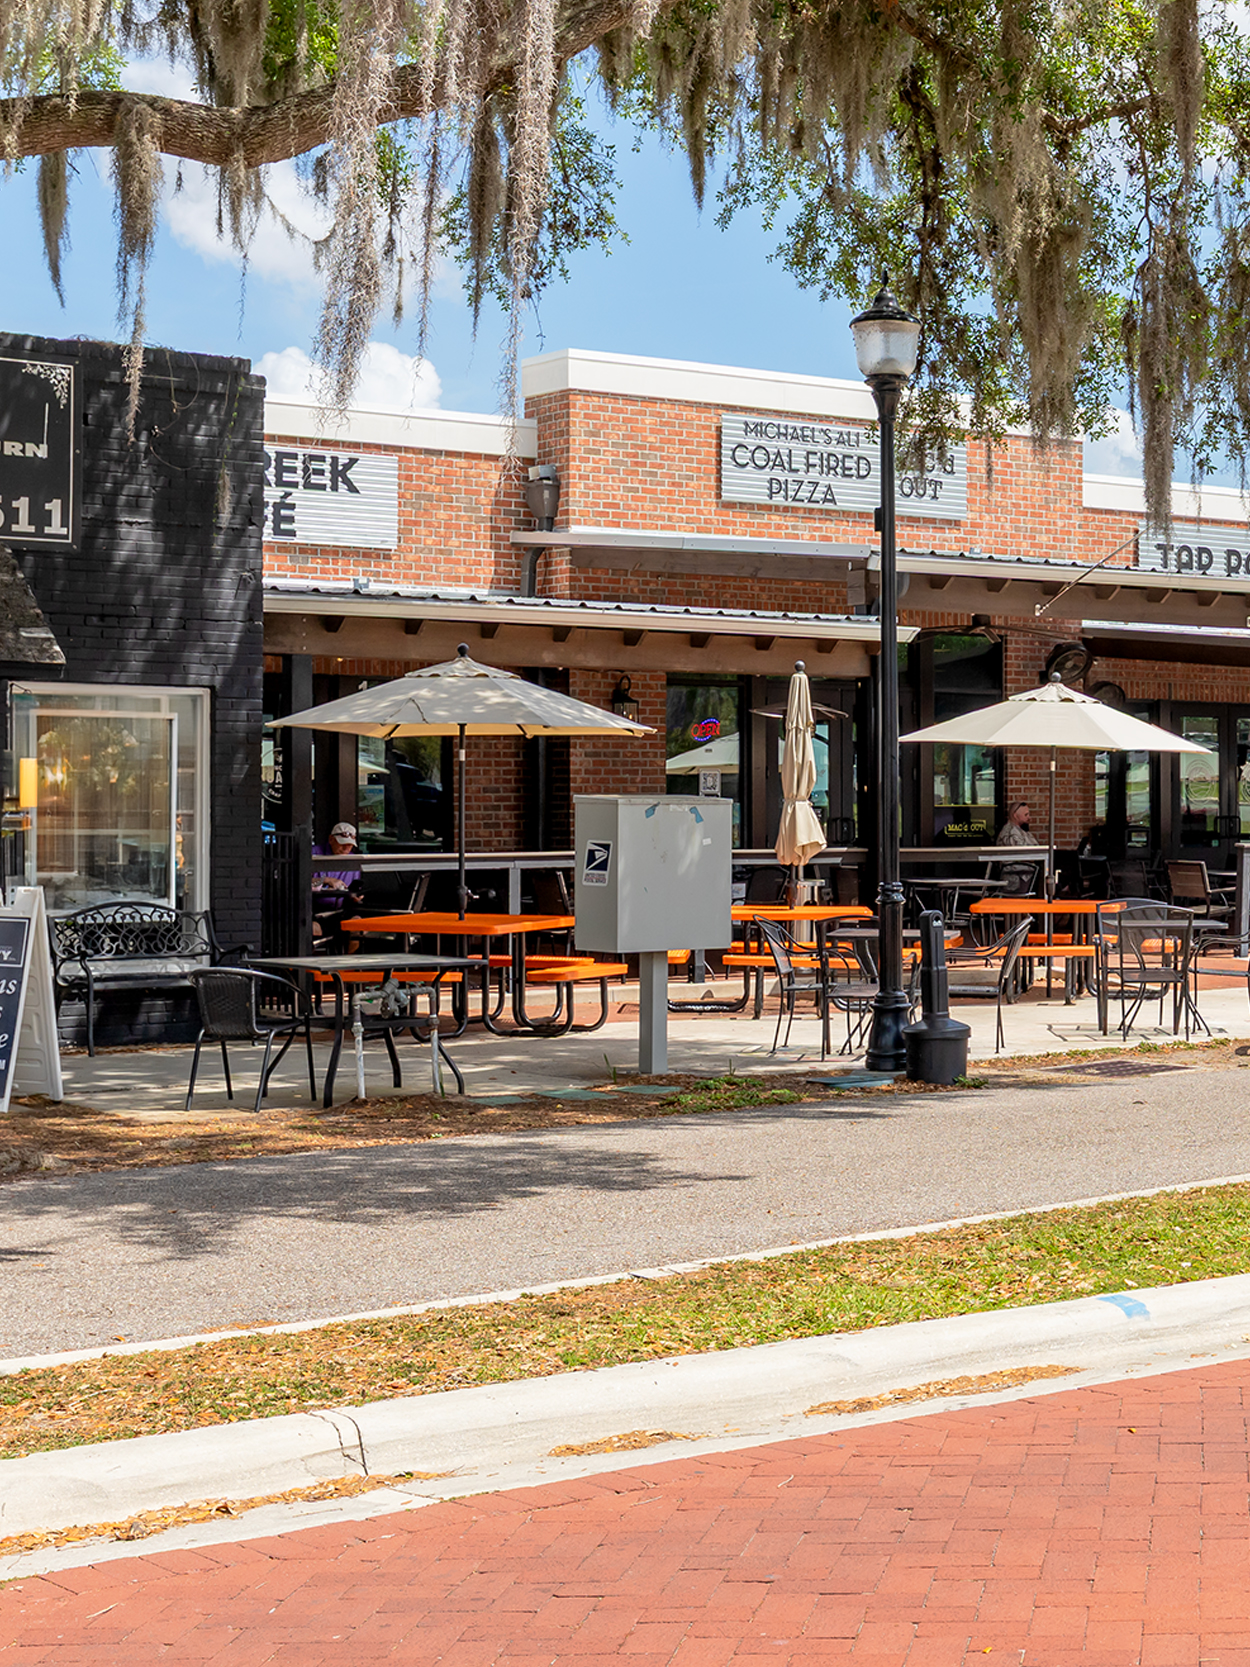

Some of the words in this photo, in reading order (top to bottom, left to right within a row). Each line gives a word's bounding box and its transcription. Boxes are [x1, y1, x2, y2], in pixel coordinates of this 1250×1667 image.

[743, 420, 833, 446] MICHAEL'S
[731, 443, 800, 473] COAL
[805, 450, 872, 480] FIRED
[767, 477, 838, 506] PIZZA
[900, 476, 943, 500] OUT
[0, 494, 68, 535] 11
[1156, 543, 1214, 572] TAP
[691, 723, 721, 738] OPEN
